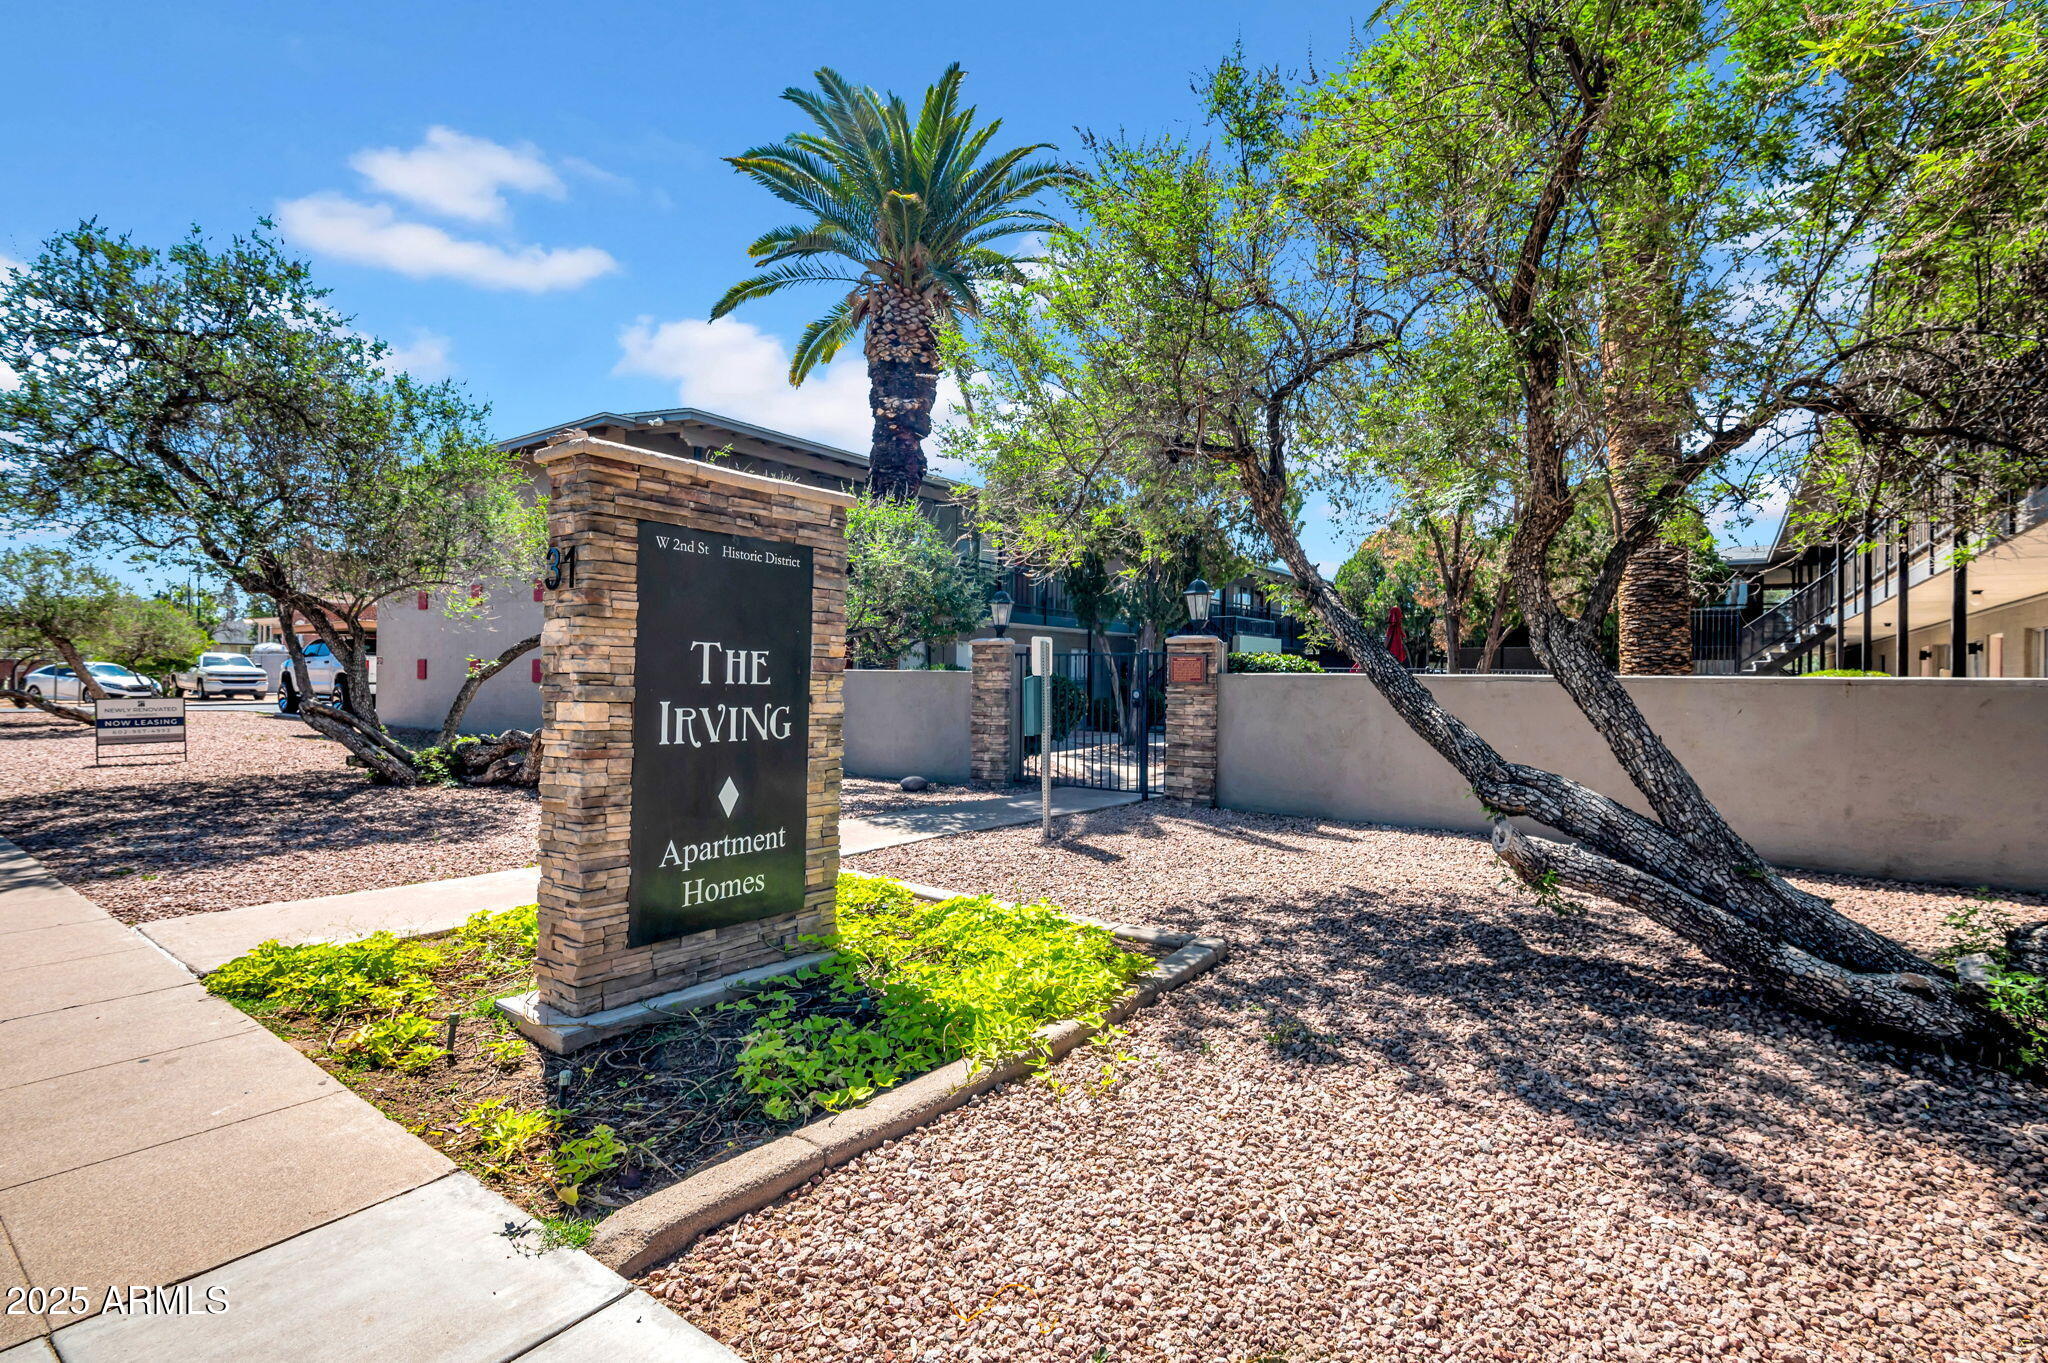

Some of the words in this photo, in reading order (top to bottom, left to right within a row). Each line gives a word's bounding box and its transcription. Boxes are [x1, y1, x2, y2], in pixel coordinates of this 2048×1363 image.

[545, 546, 577, 590] 31
[656, 535, 669, 549] W
[673, 538, 695, 553] 2nd
[698, 542, 710, 555] St
[722, 546, 763, 563] Historic
[765, 552, 801, 568] District
[690, 640, 771, 685] THE
[134, 718, 178, 726] LEASING
[658, 701, 792, 748] IRVING
[658, 826, 786, 872] Apartment
[681, 873, 765, 908] Homes
